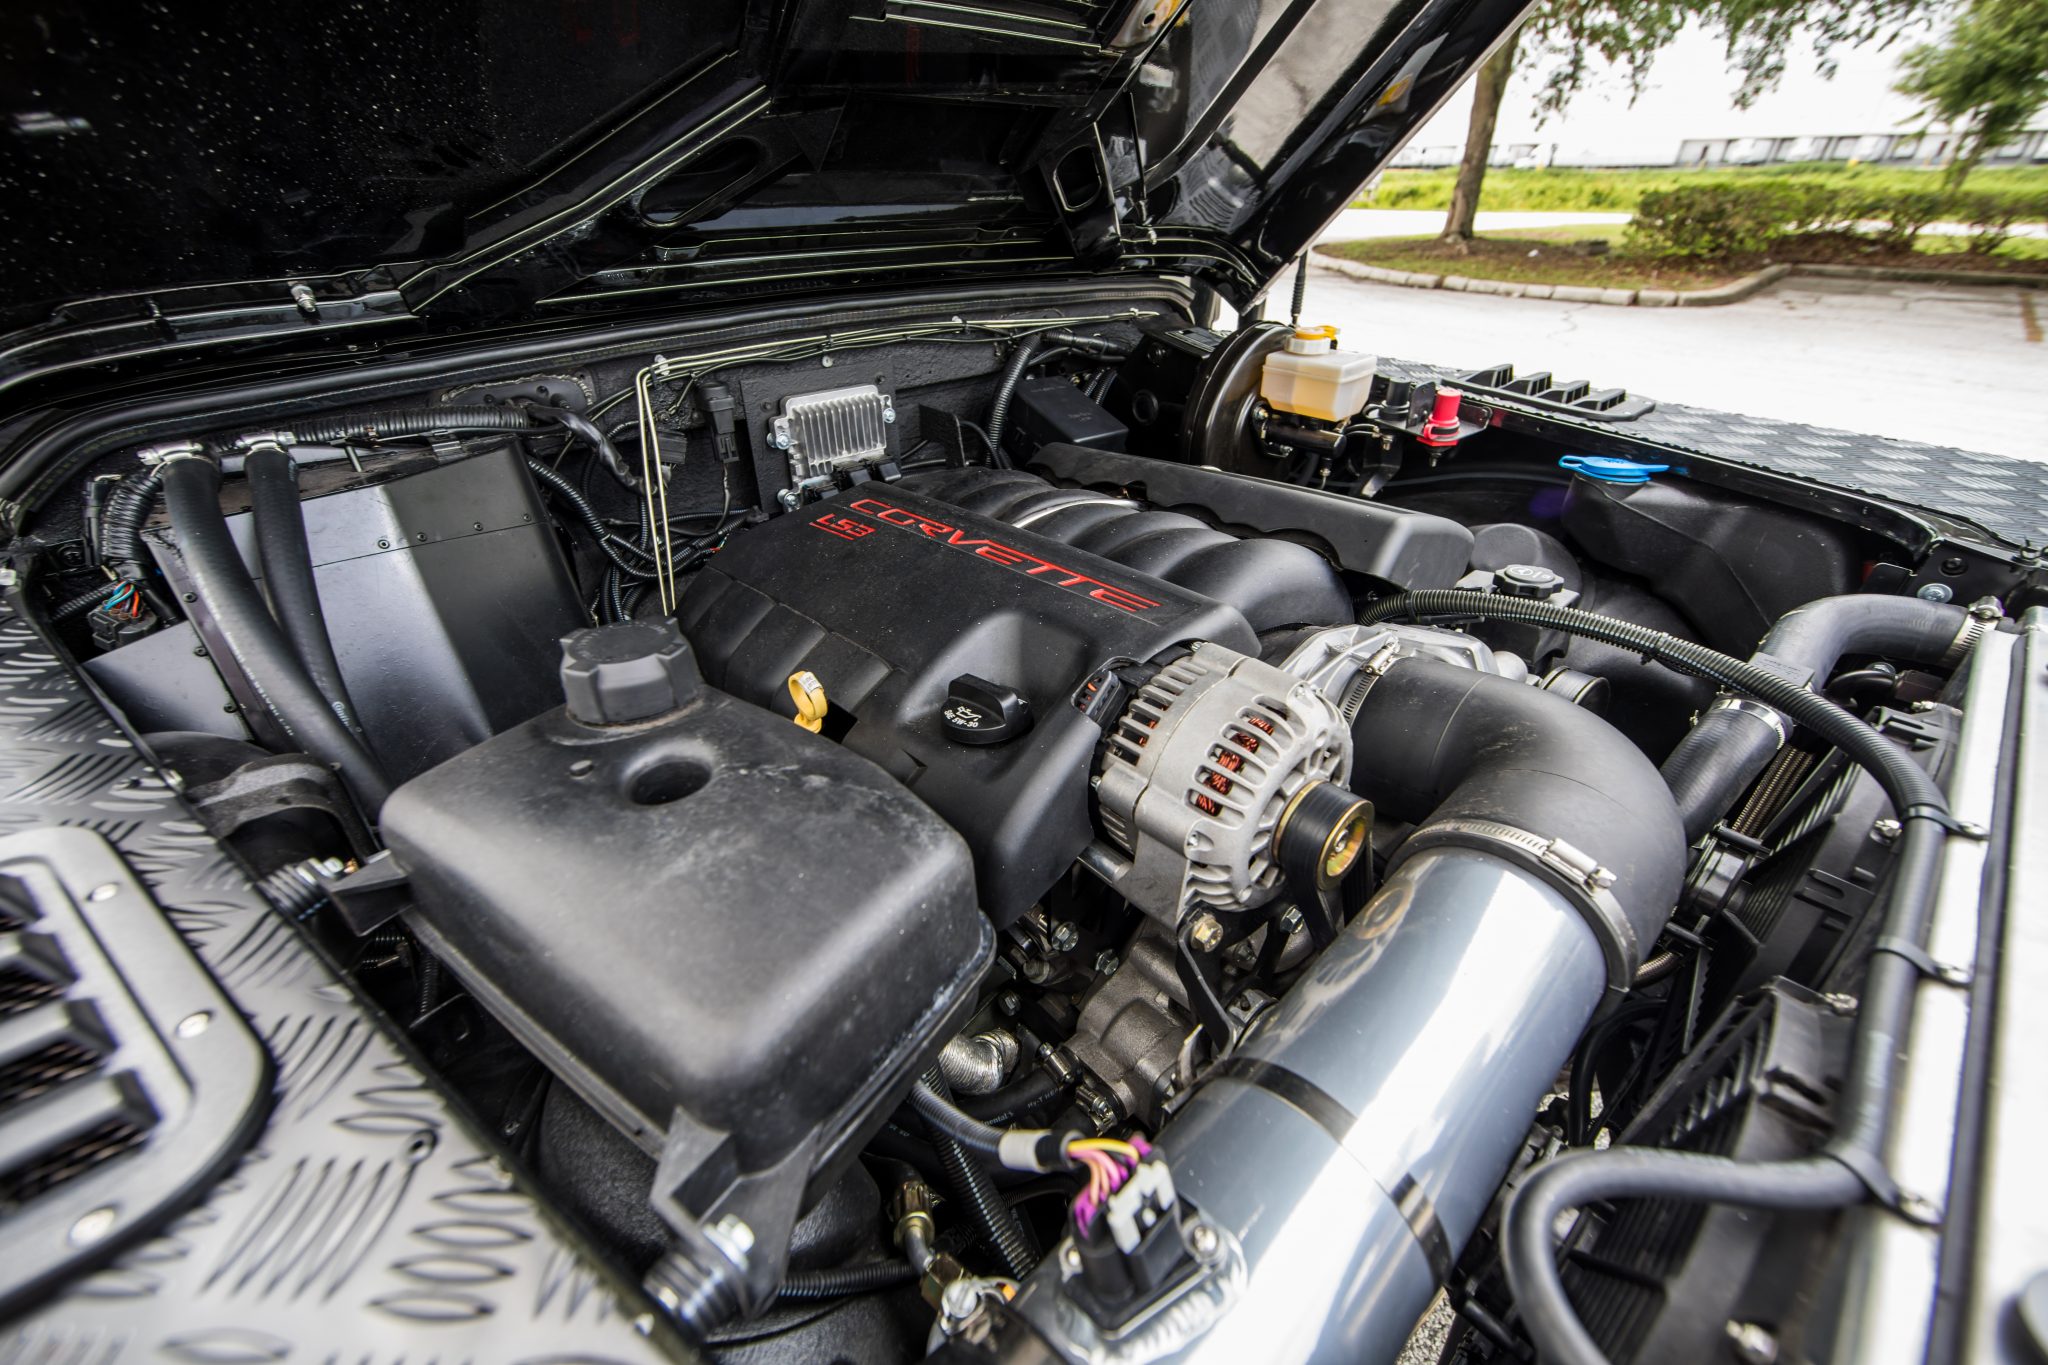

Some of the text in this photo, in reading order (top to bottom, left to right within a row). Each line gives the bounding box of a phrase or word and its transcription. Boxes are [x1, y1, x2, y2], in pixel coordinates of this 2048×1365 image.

[817, 513, 877, 538] LS3
[850, 498, 1162, 612] CORVETTE
[944, 709, 979, 728] SAE 5W-30
